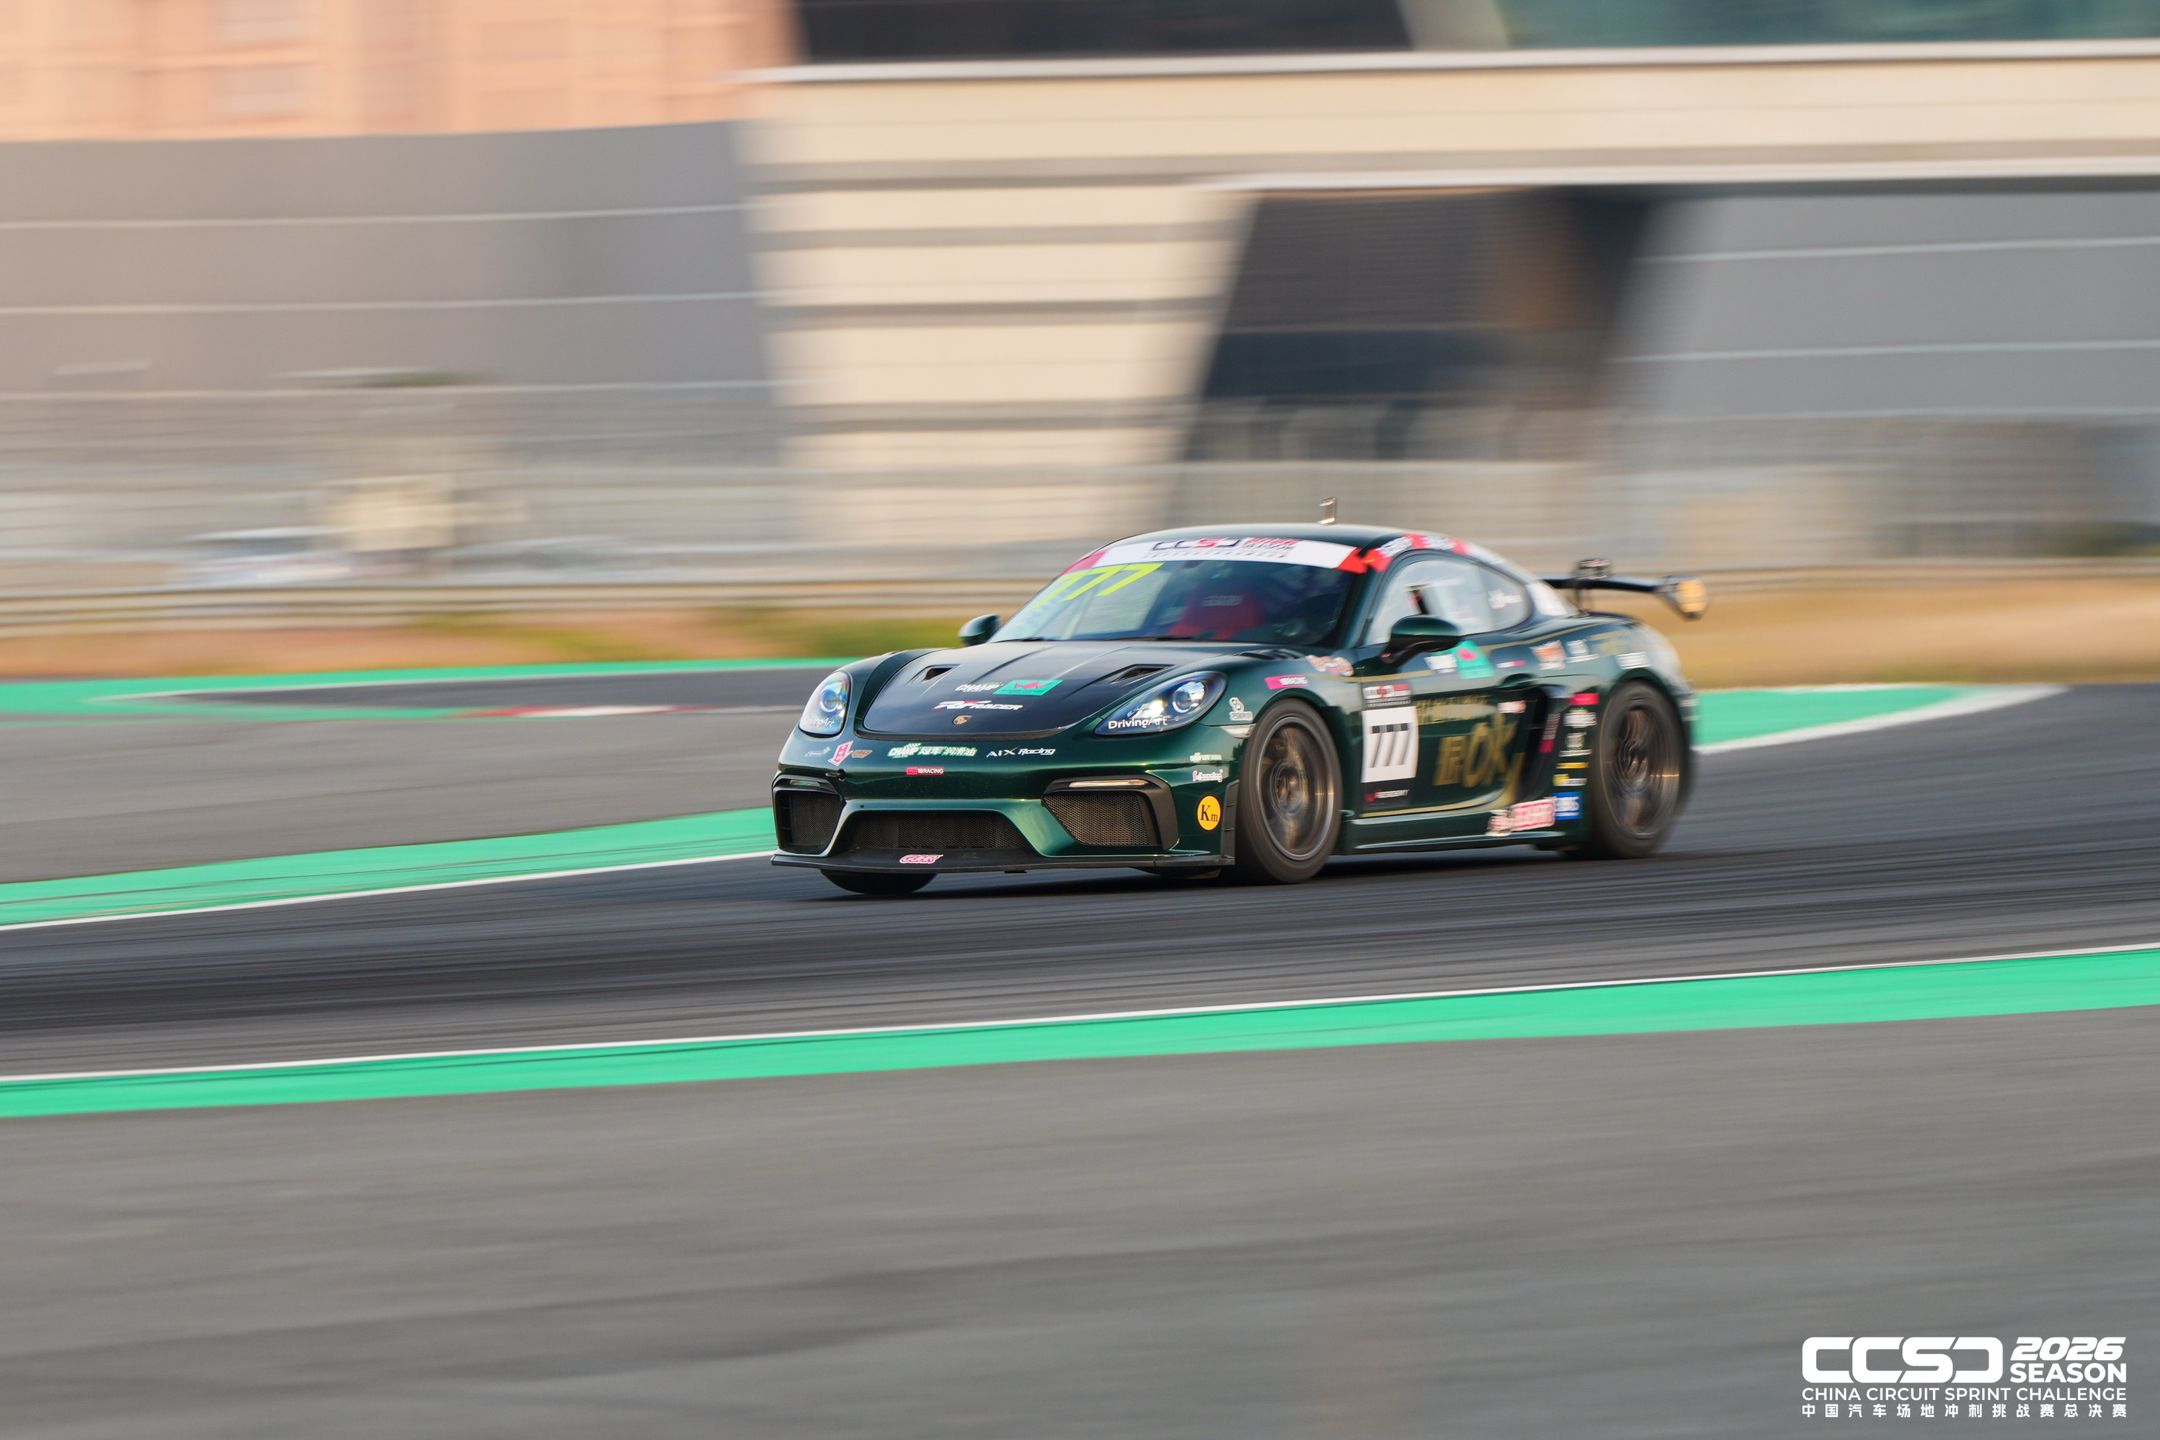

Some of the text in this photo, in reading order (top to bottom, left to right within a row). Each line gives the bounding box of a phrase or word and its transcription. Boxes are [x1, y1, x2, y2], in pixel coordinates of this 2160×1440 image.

[1108, 715, 1169, 729] DrivingArt
[1018, 747, 1056, 756] Racing
[1370, 722, 1409, 768] 777
